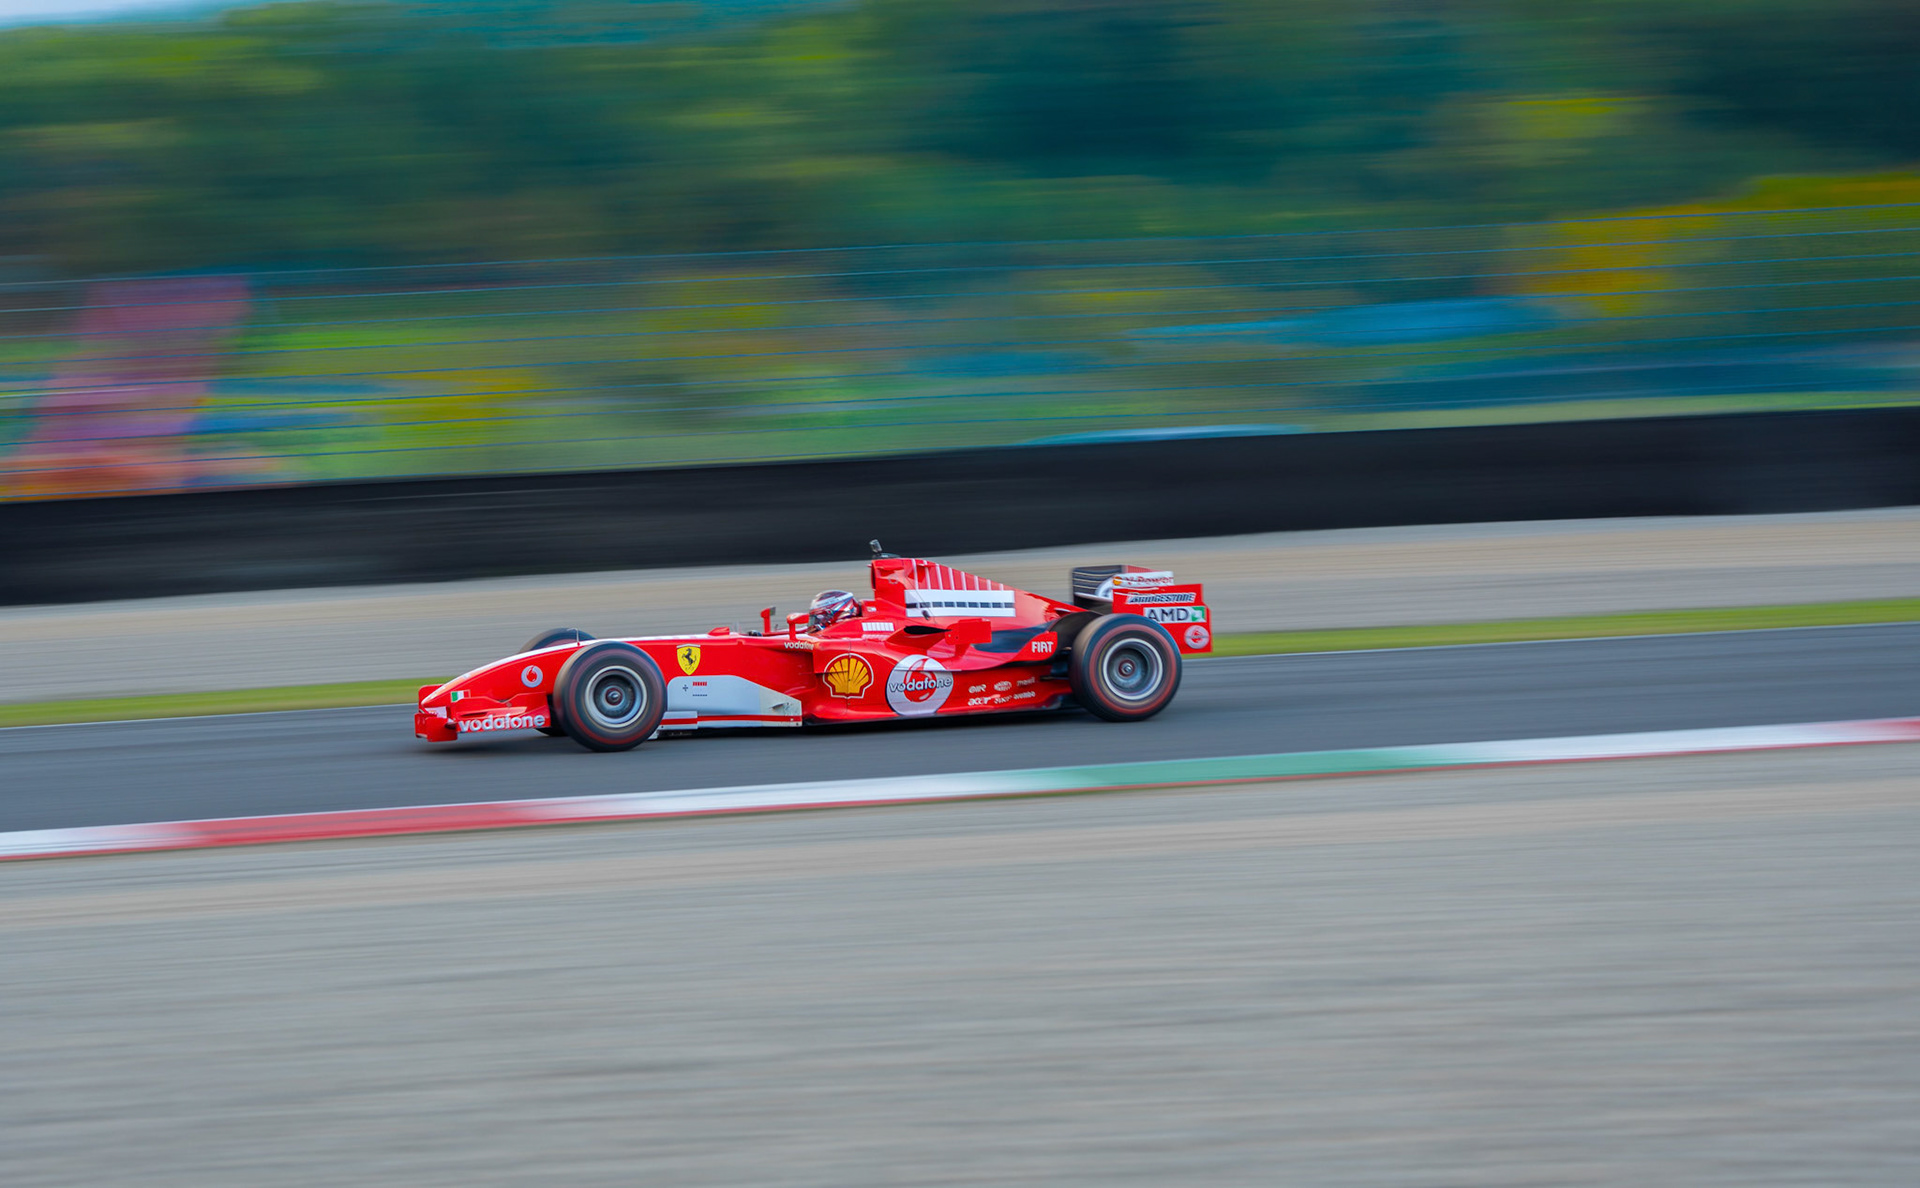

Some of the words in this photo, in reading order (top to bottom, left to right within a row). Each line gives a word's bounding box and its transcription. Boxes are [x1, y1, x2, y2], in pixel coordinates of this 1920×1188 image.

[1148, 608, 1189, 622] AMD
[1032, 641, 1054, 653] FIAT
[889, 677, 953, 693] vodafone
[459, 714, 546, 732] vodafone
